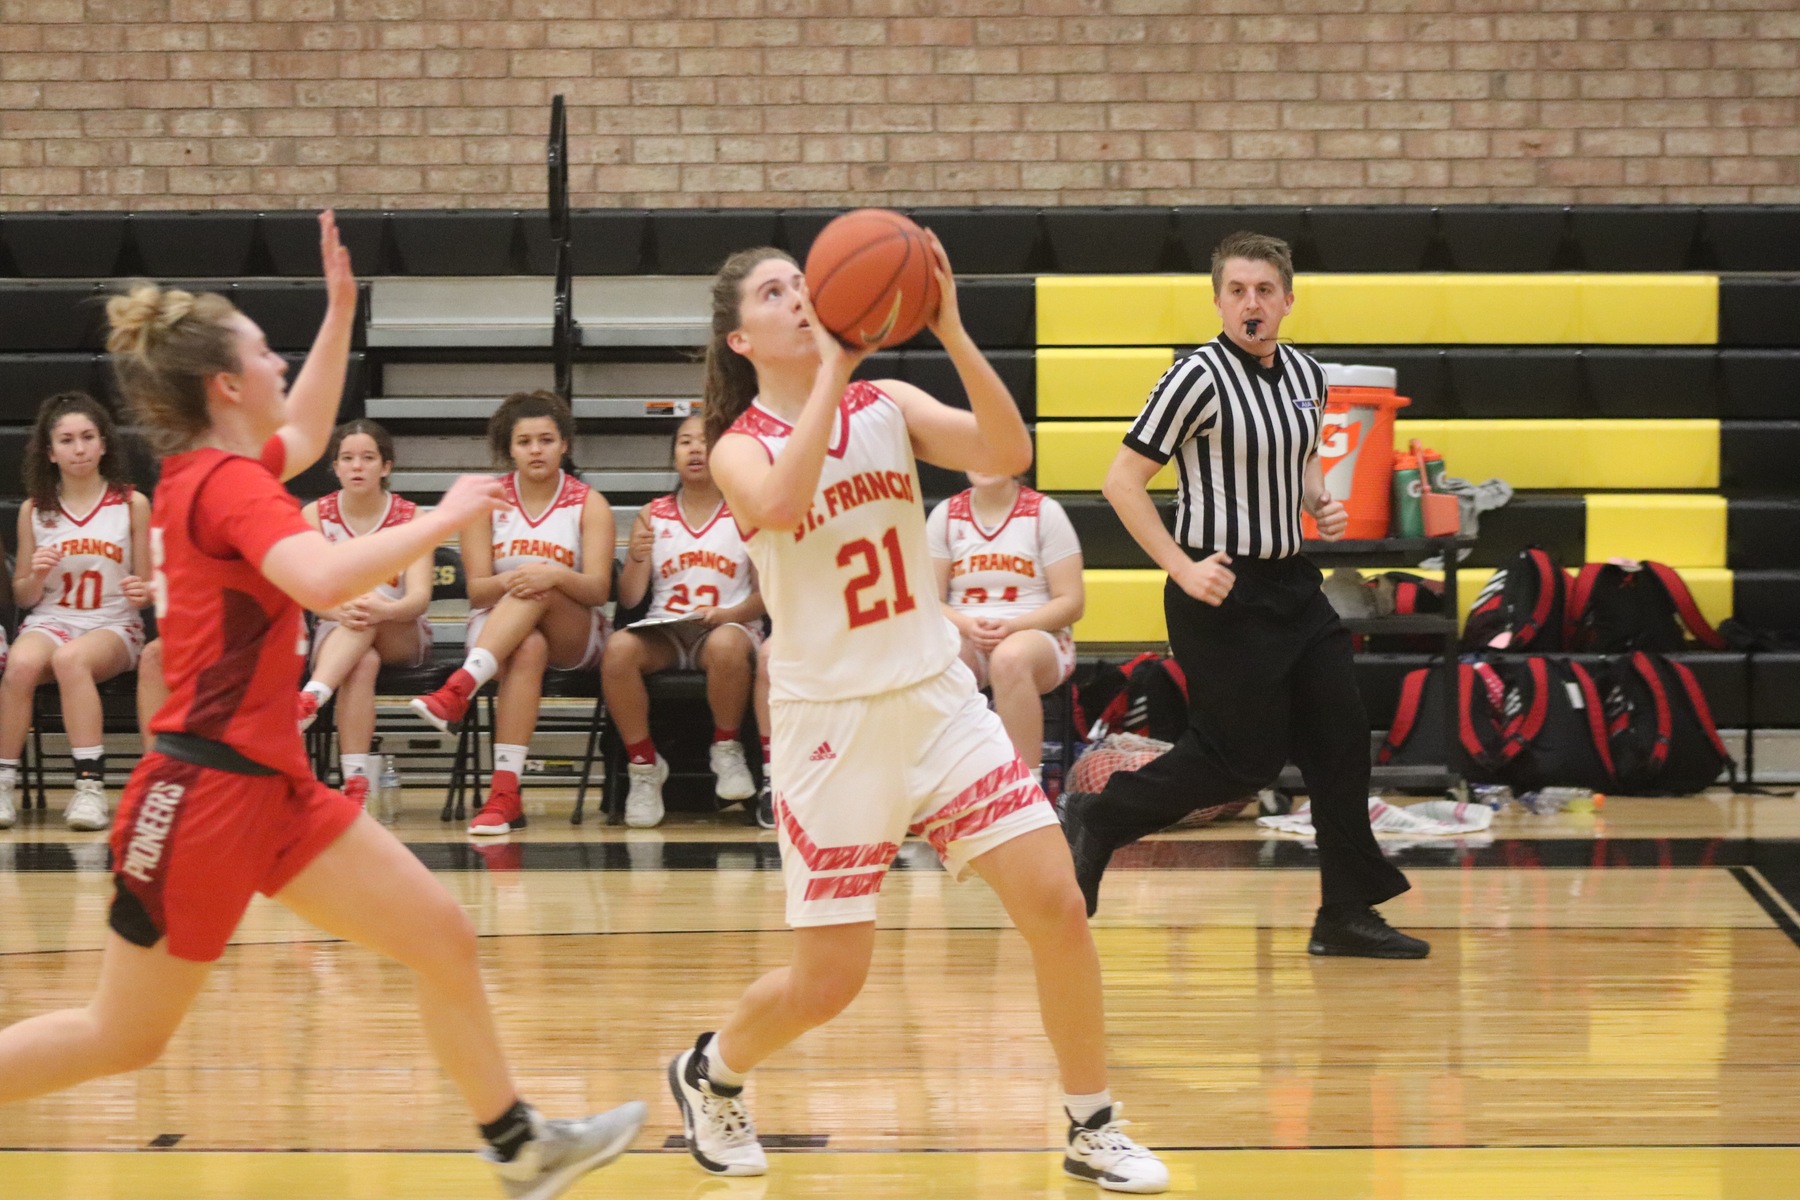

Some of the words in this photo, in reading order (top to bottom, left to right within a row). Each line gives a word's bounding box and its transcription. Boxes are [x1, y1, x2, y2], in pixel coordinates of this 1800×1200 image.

[61, 538, 123, 564] FRANCIS
[509, 539, 574, 568] FRANCIS
[660, 558, 678, 579] ST.
[678, 549, 737, 579] FRANCIS
[970, 553, 1035, 578] FRANCIS
[836, 525, 916, 630] 21
[122, 780, 186, 882] PIONEERS
